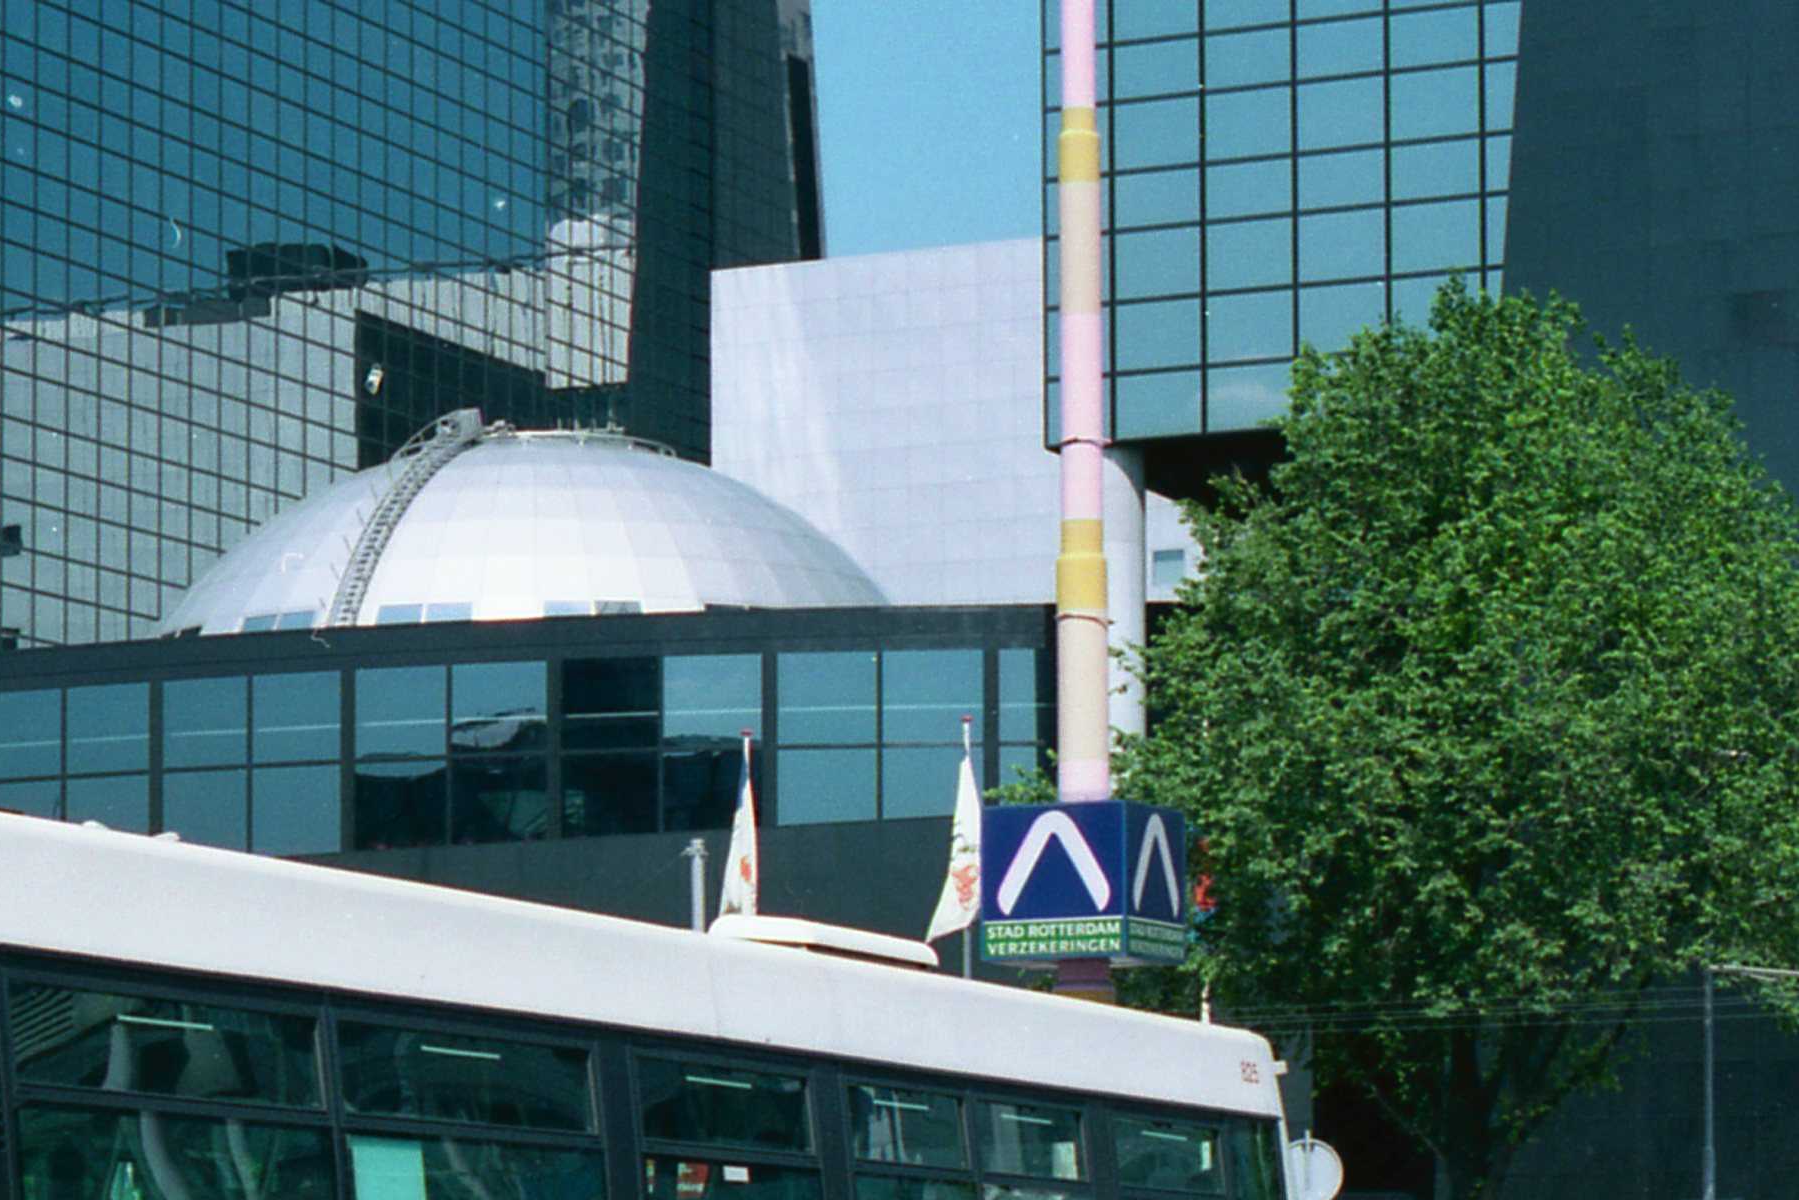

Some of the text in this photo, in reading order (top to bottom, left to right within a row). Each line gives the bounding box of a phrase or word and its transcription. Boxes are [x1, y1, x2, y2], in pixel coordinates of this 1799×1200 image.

[987, 921, 1121, 940] STAD ROTTERDAM
[987, 938, 1121, 955] VERZEKERINGEN
